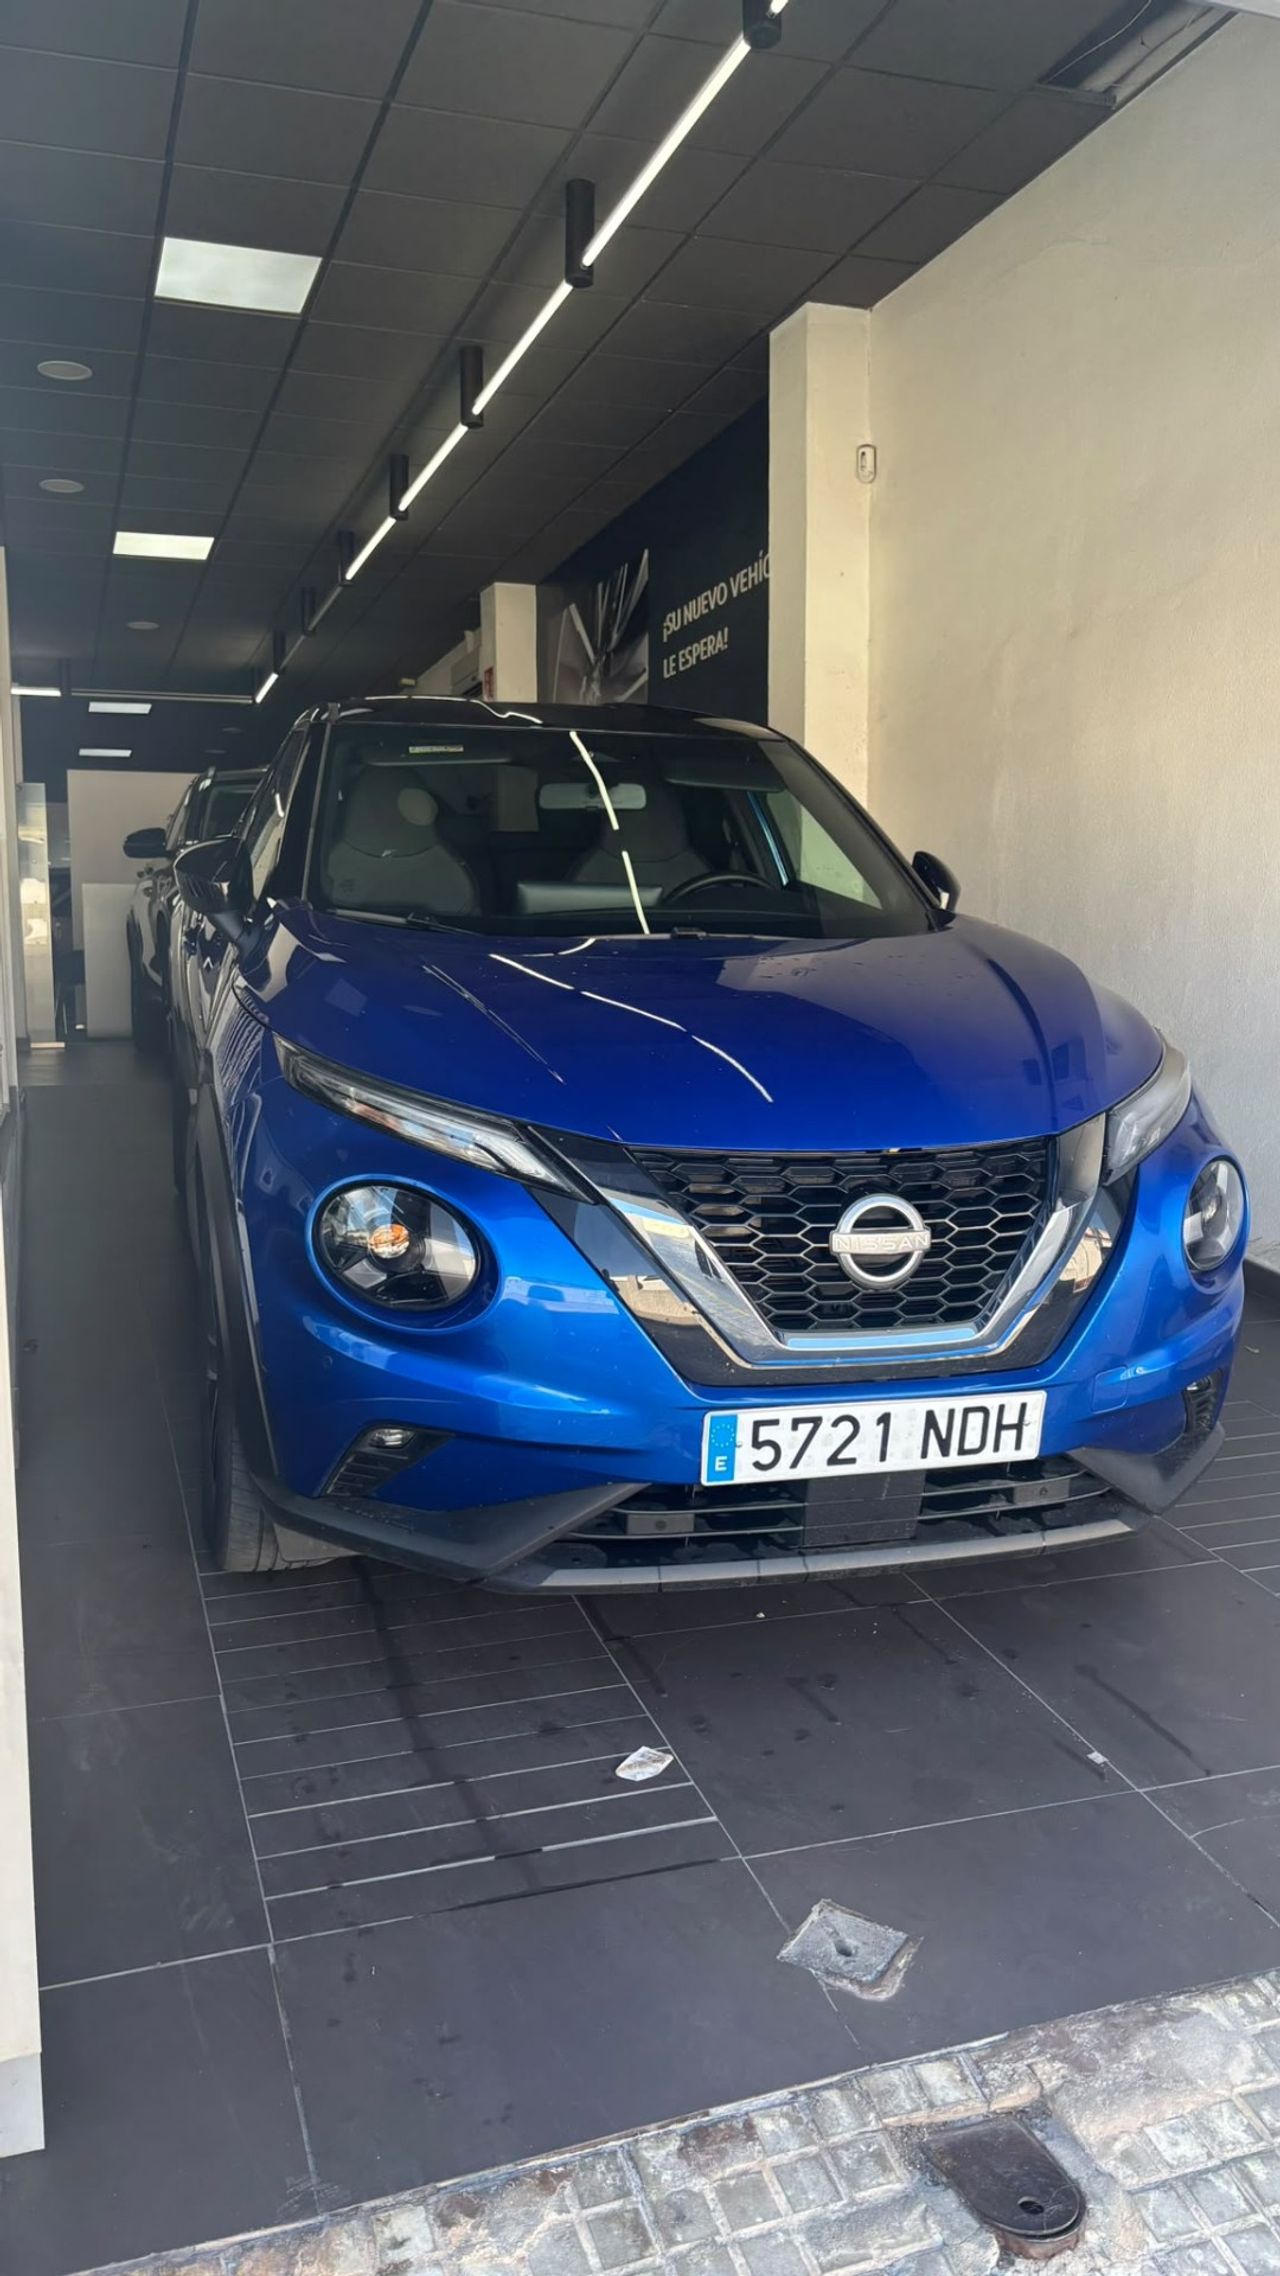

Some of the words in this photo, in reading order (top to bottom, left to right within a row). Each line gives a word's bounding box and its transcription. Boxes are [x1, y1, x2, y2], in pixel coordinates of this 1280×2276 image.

[683, 581, 728, 626] NUEVO
[663, 654, 677, 680] LE
[678, 627, 729, 672] ESPERA!
[835, 1232, 929, 1251] NISSAN
[751, 1412, 892, 1472] 5721
[920, 1402, 1028, 1460] NDH
[714, 1455, 728, 1472] E
